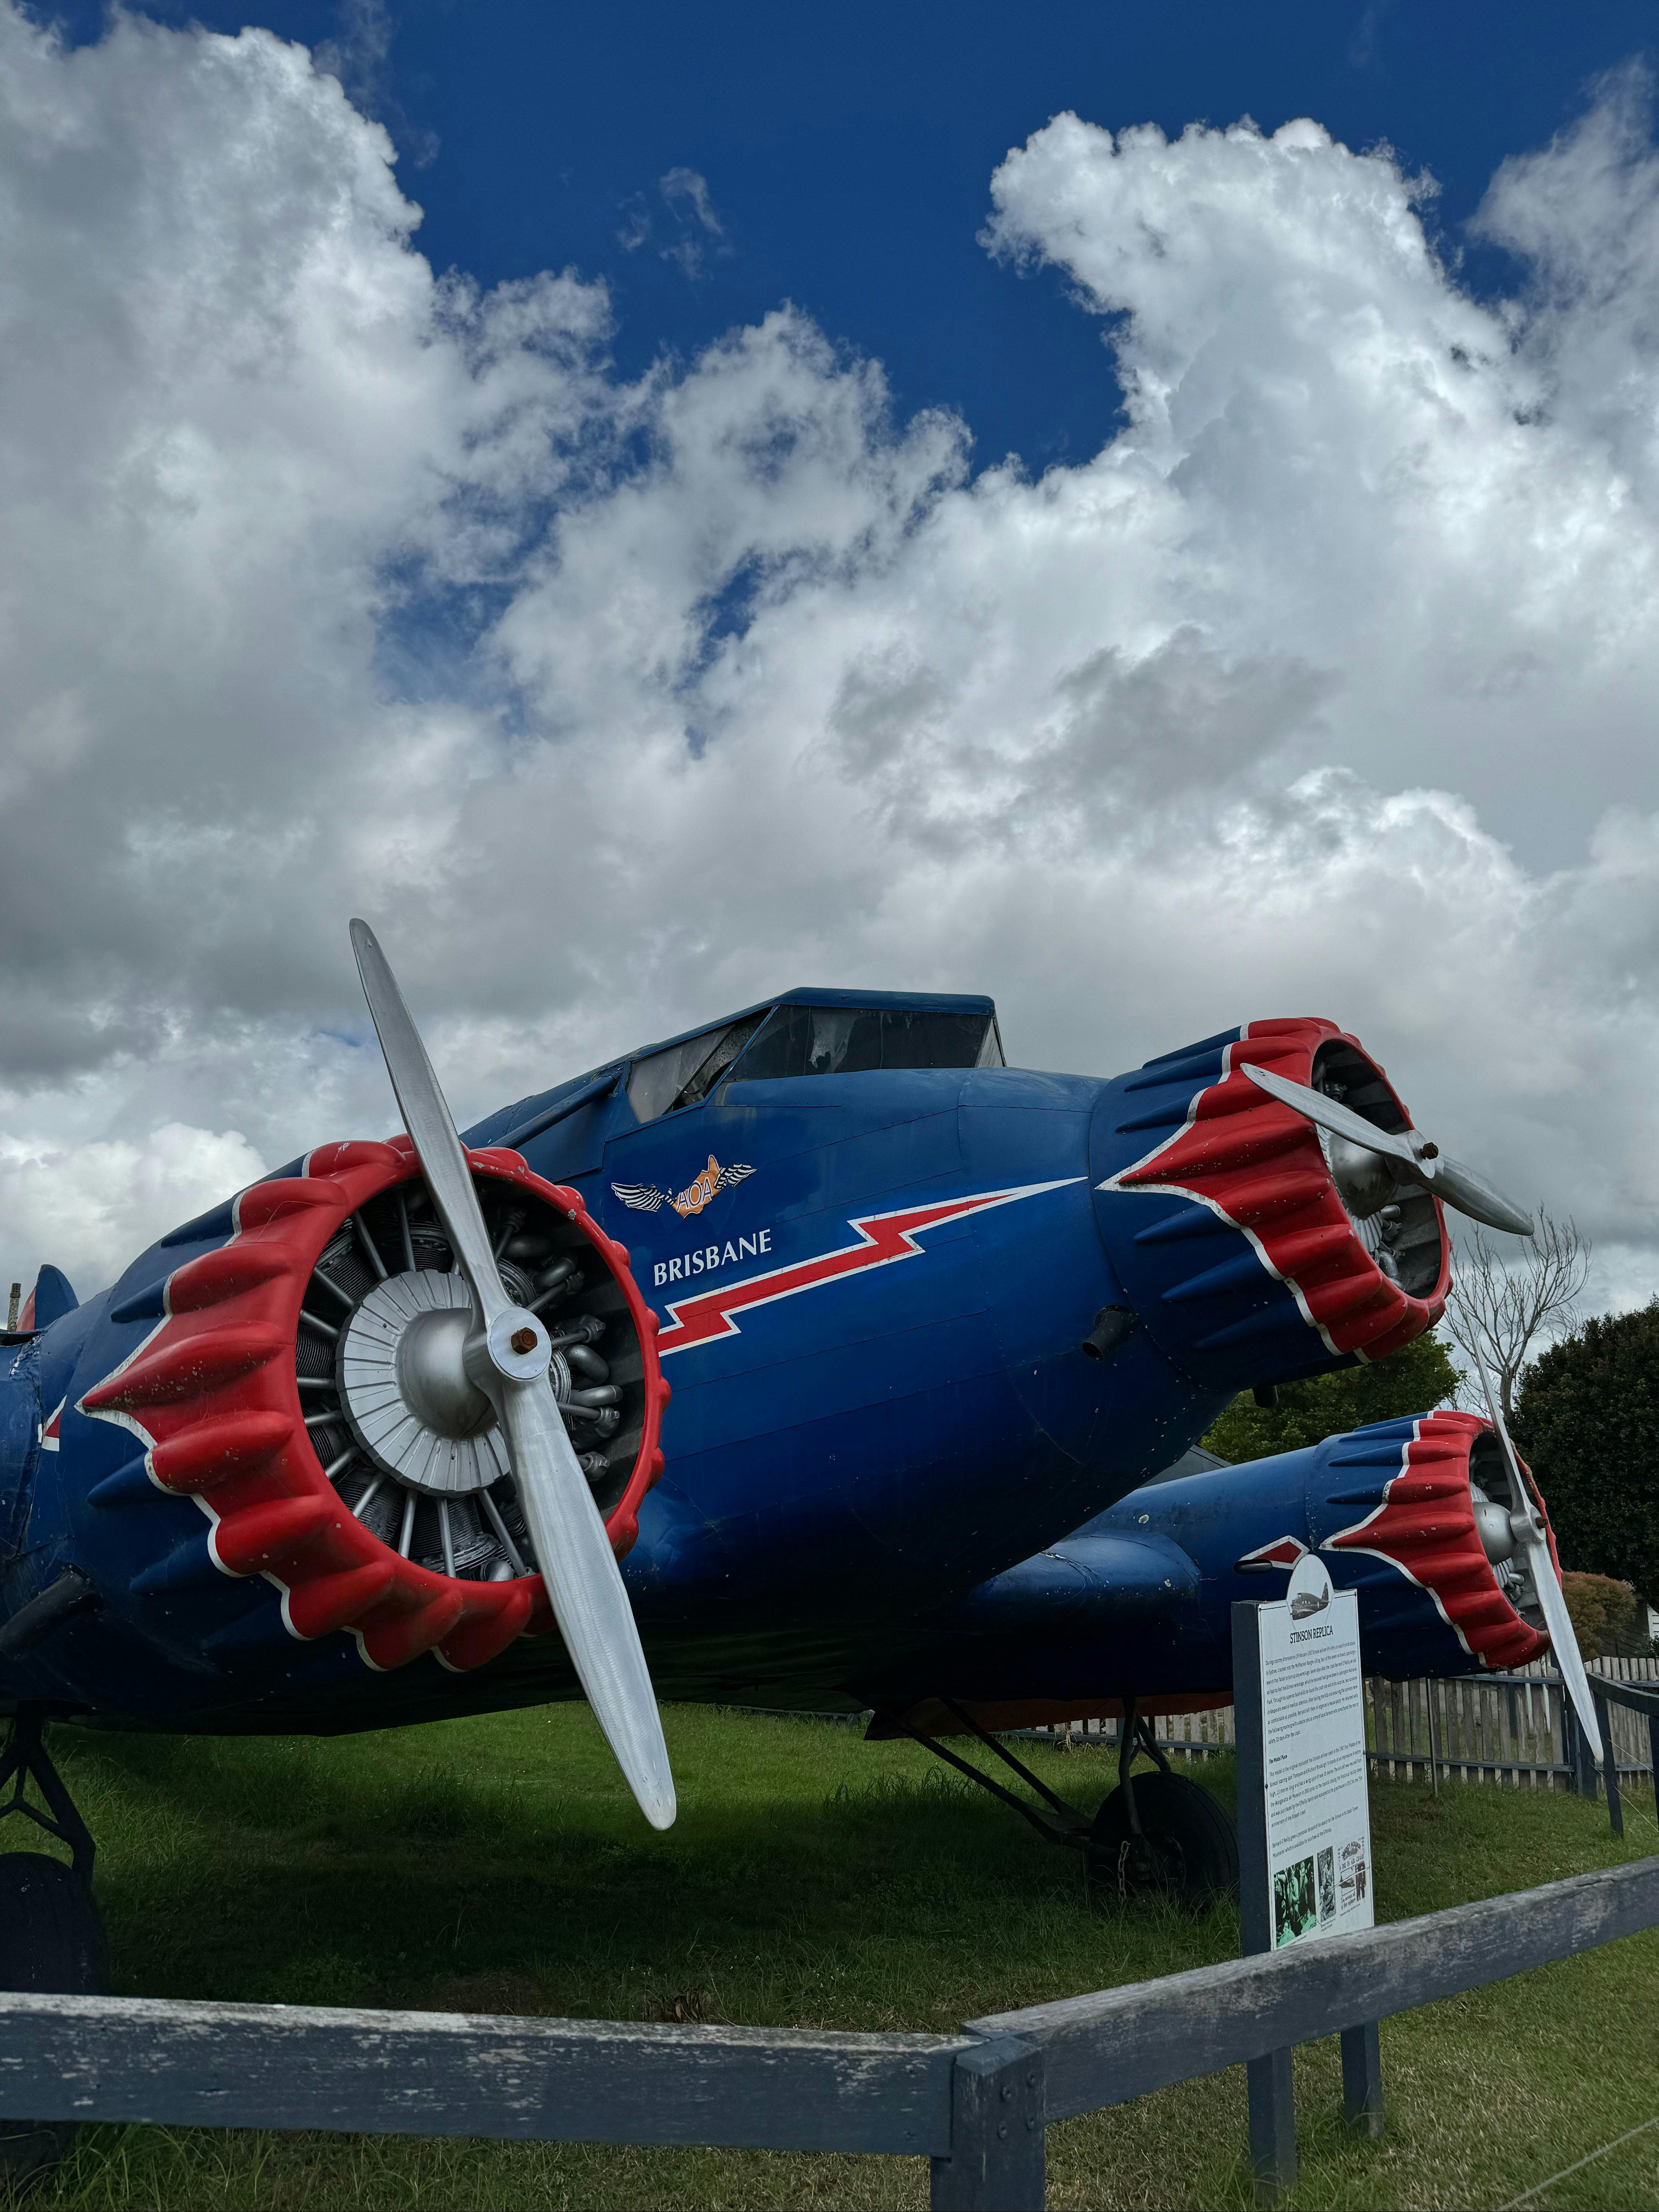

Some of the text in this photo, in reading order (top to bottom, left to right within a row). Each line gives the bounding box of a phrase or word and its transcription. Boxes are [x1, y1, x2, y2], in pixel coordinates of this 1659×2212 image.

[676, 1177, 713, 1212] AOA
[654, 1229, 771, 1286] BRISBANE
[1290, 1625, 1333, 1643] STINSON REPLICA
